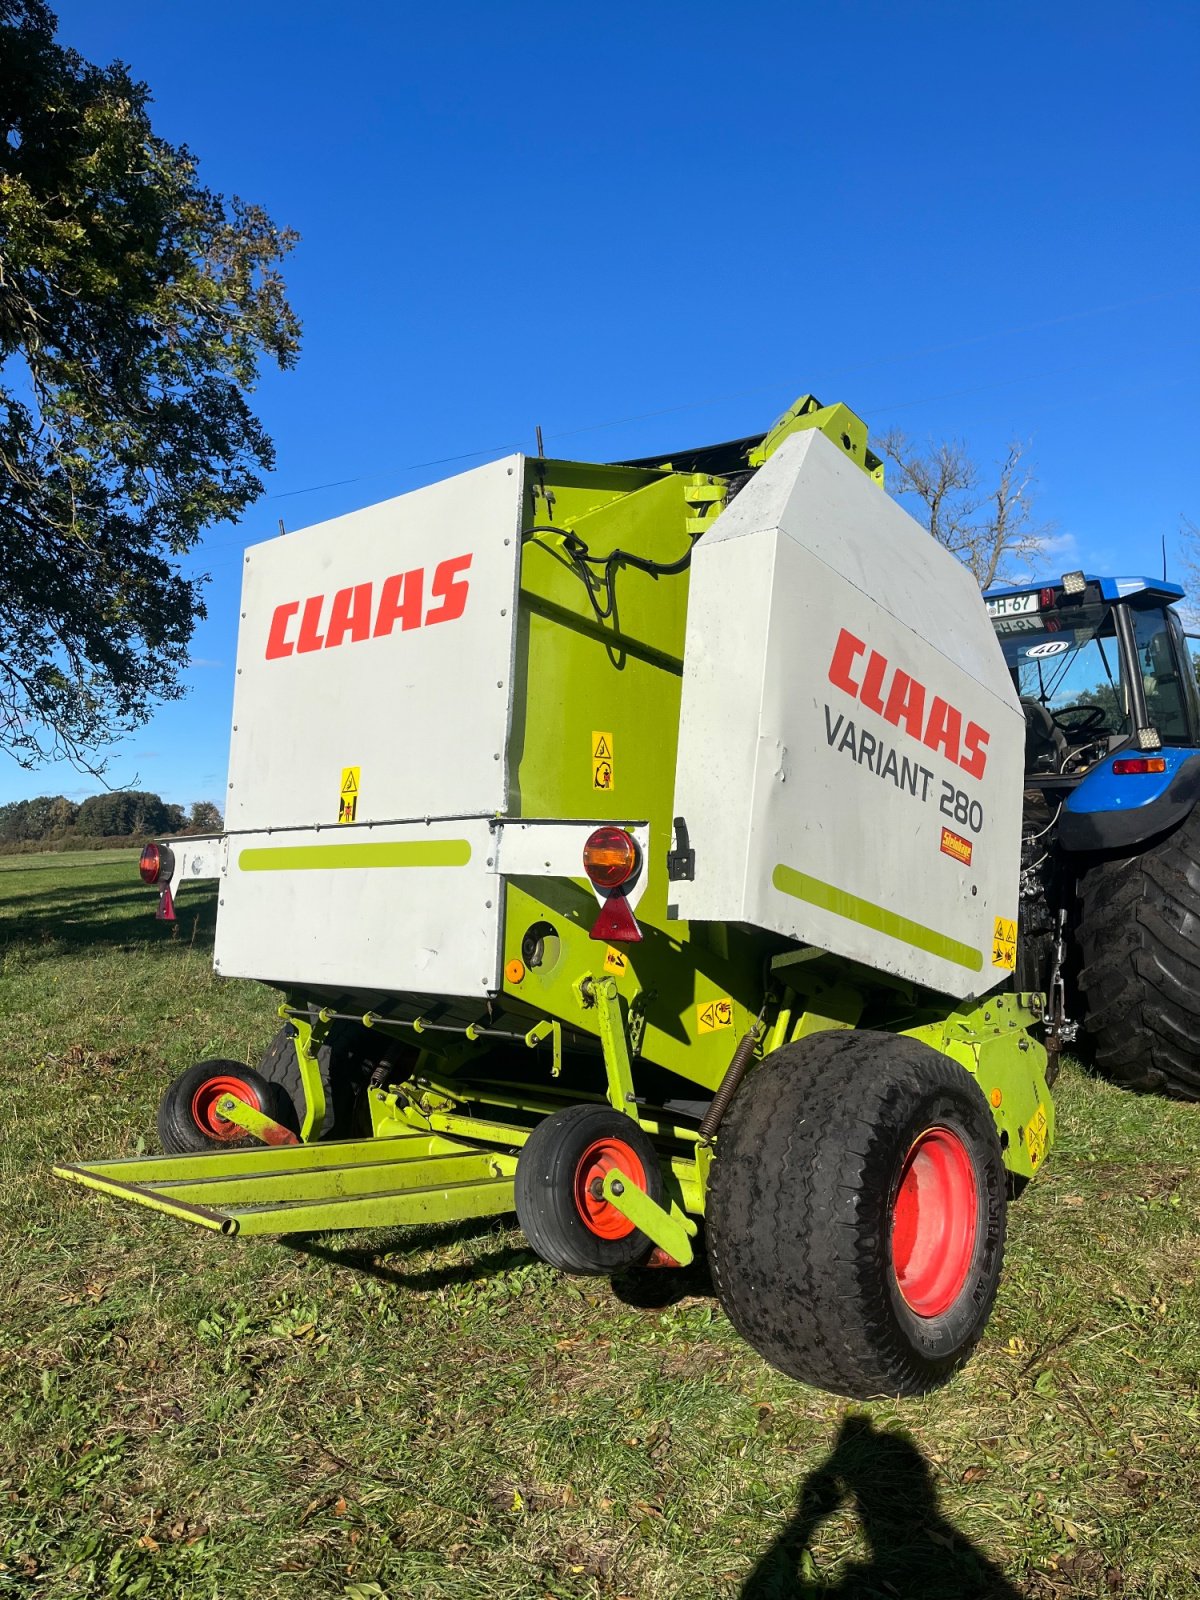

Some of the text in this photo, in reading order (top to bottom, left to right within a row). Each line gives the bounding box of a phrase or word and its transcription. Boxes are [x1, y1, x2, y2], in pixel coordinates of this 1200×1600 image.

[265, 553, 473, 660] CLAAS
[1033, 644, 1061, 655] 40
[828, 627, 991, 780] CLAAS
[825, 704, 983, 833] VARIANT 280
